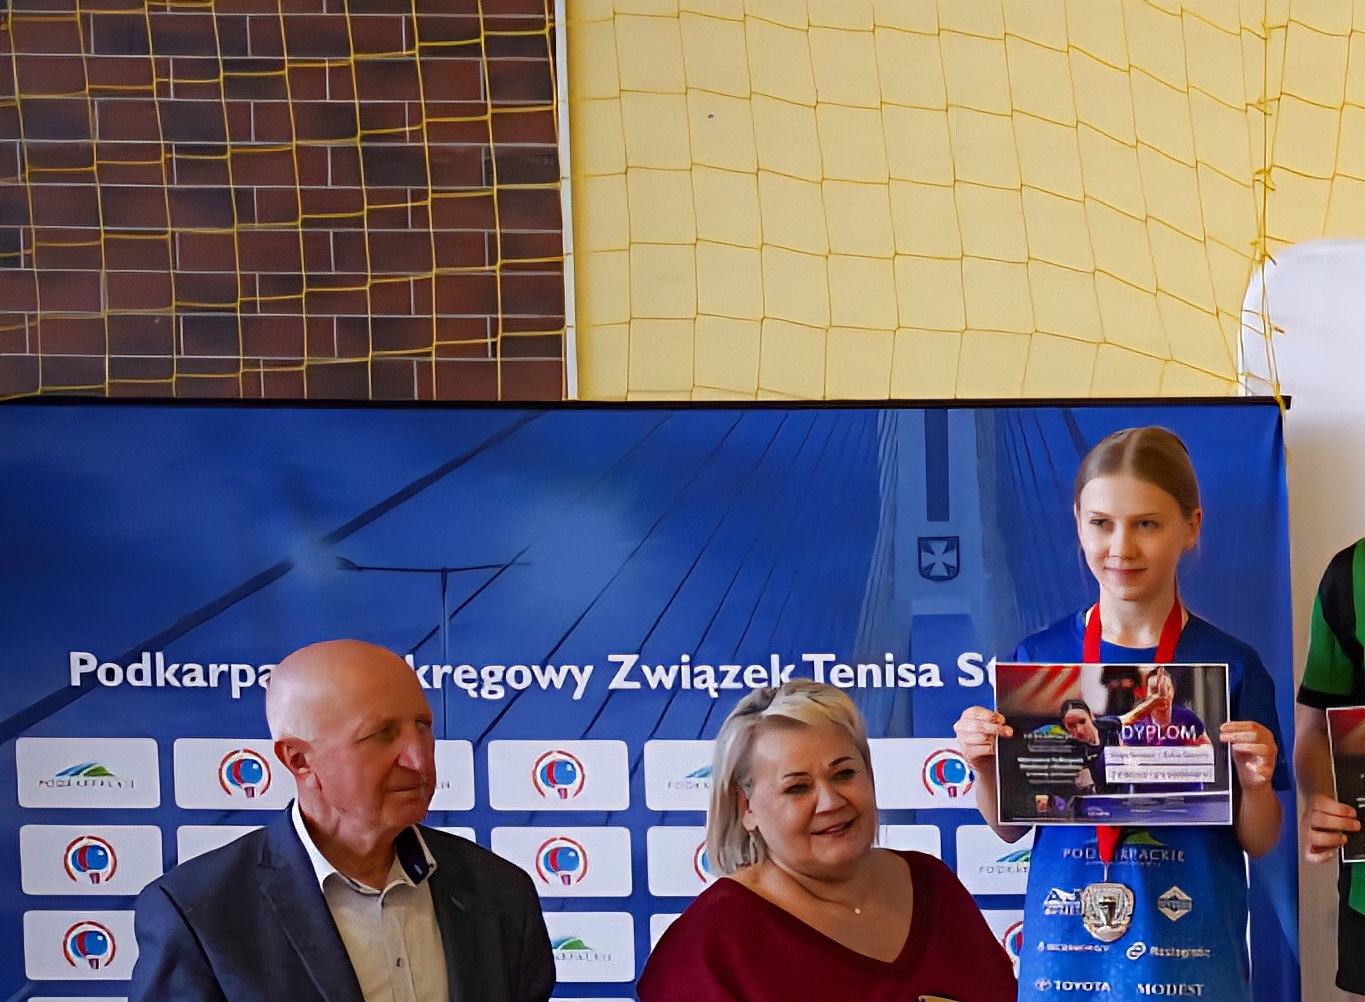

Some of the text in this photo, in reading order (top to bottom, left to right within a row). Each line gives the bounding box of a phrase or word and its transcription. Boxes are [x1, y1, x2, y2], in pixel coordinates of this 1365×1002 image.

[69, 651, 276, 699] Podkarpa
[403, 653, 594, 700] kręgowy
[607, 653, 796, 699] Związek
[801, 652, 944, 688] Tenisa
[1122, 725, 1197, 741] DYPLOM
[1054, 980, 1111, 992] TOYOTA
[1136, 983, 1205, 996] MODEST
